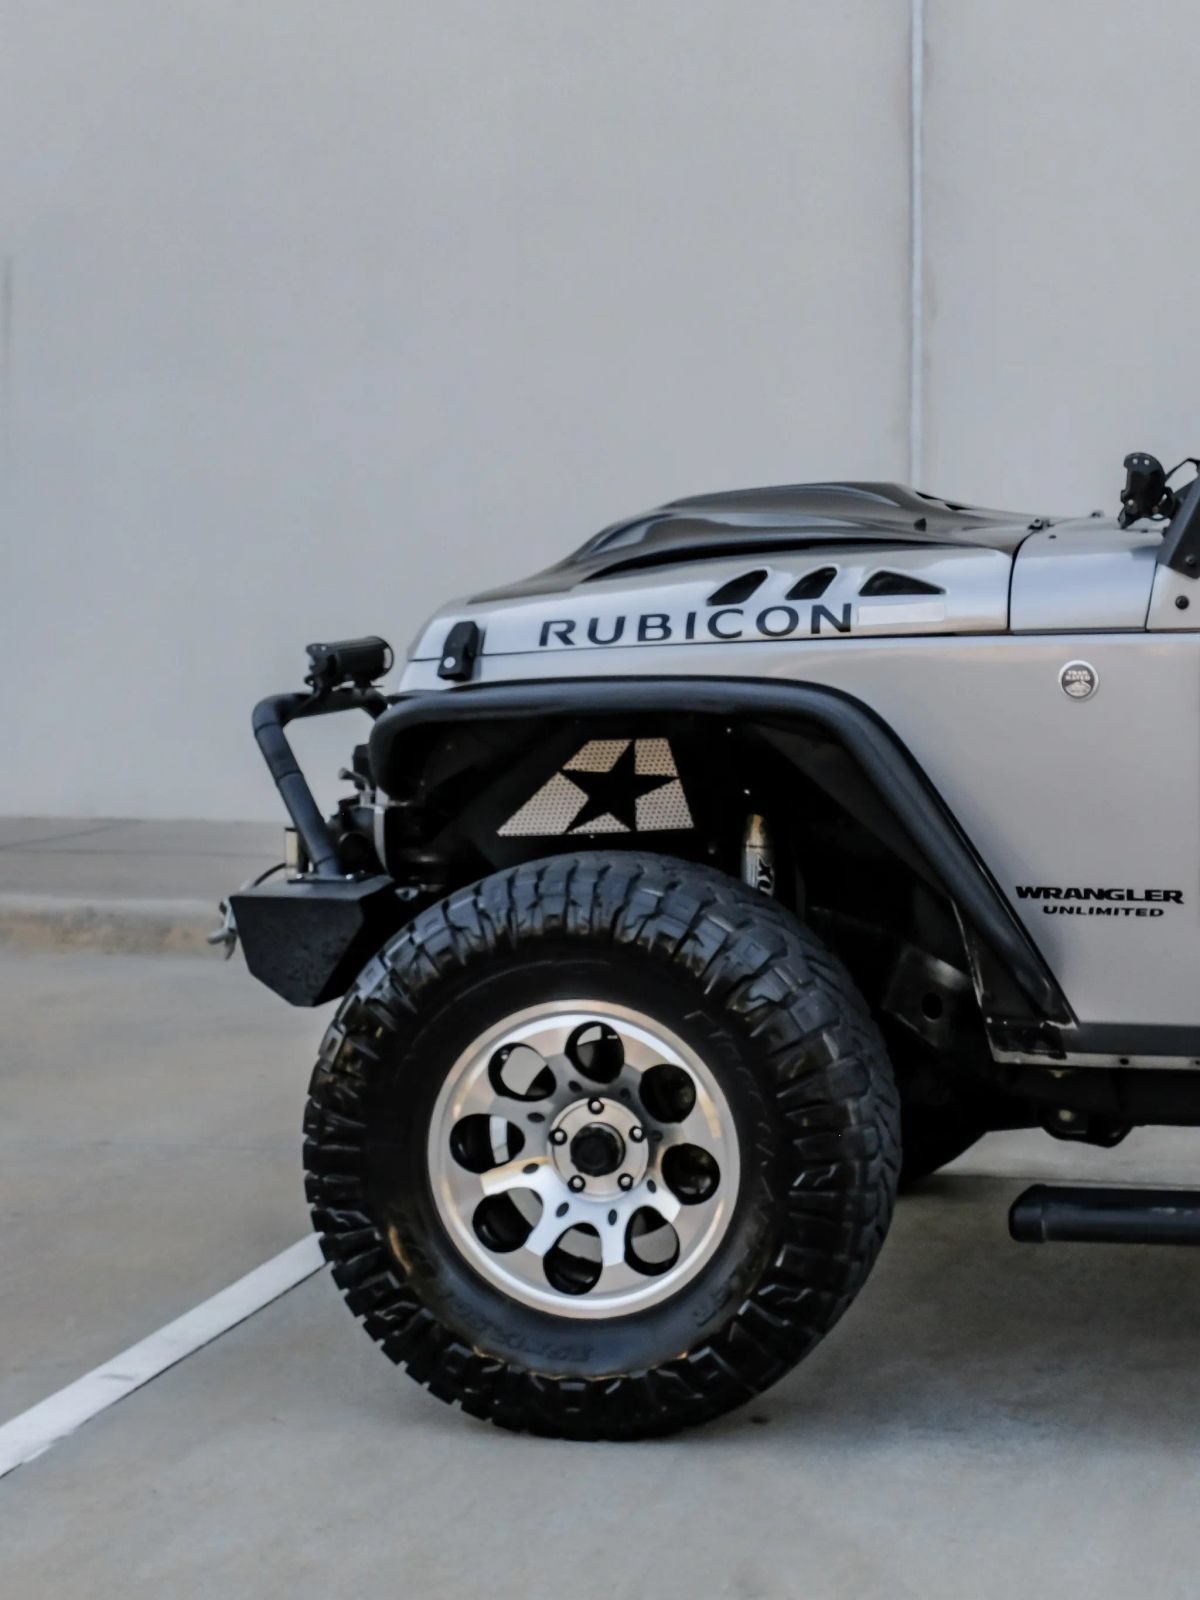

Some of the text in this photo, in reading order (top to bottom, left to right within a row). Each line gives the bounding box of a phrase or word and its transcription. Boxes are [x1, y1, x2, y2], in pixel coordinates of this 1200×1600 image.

[538, 603, 852, 647] RUBICON
[1015, 886, 1184, 904] WRANGLER
[1043, 905, 1164, 917] UNLIMITED
